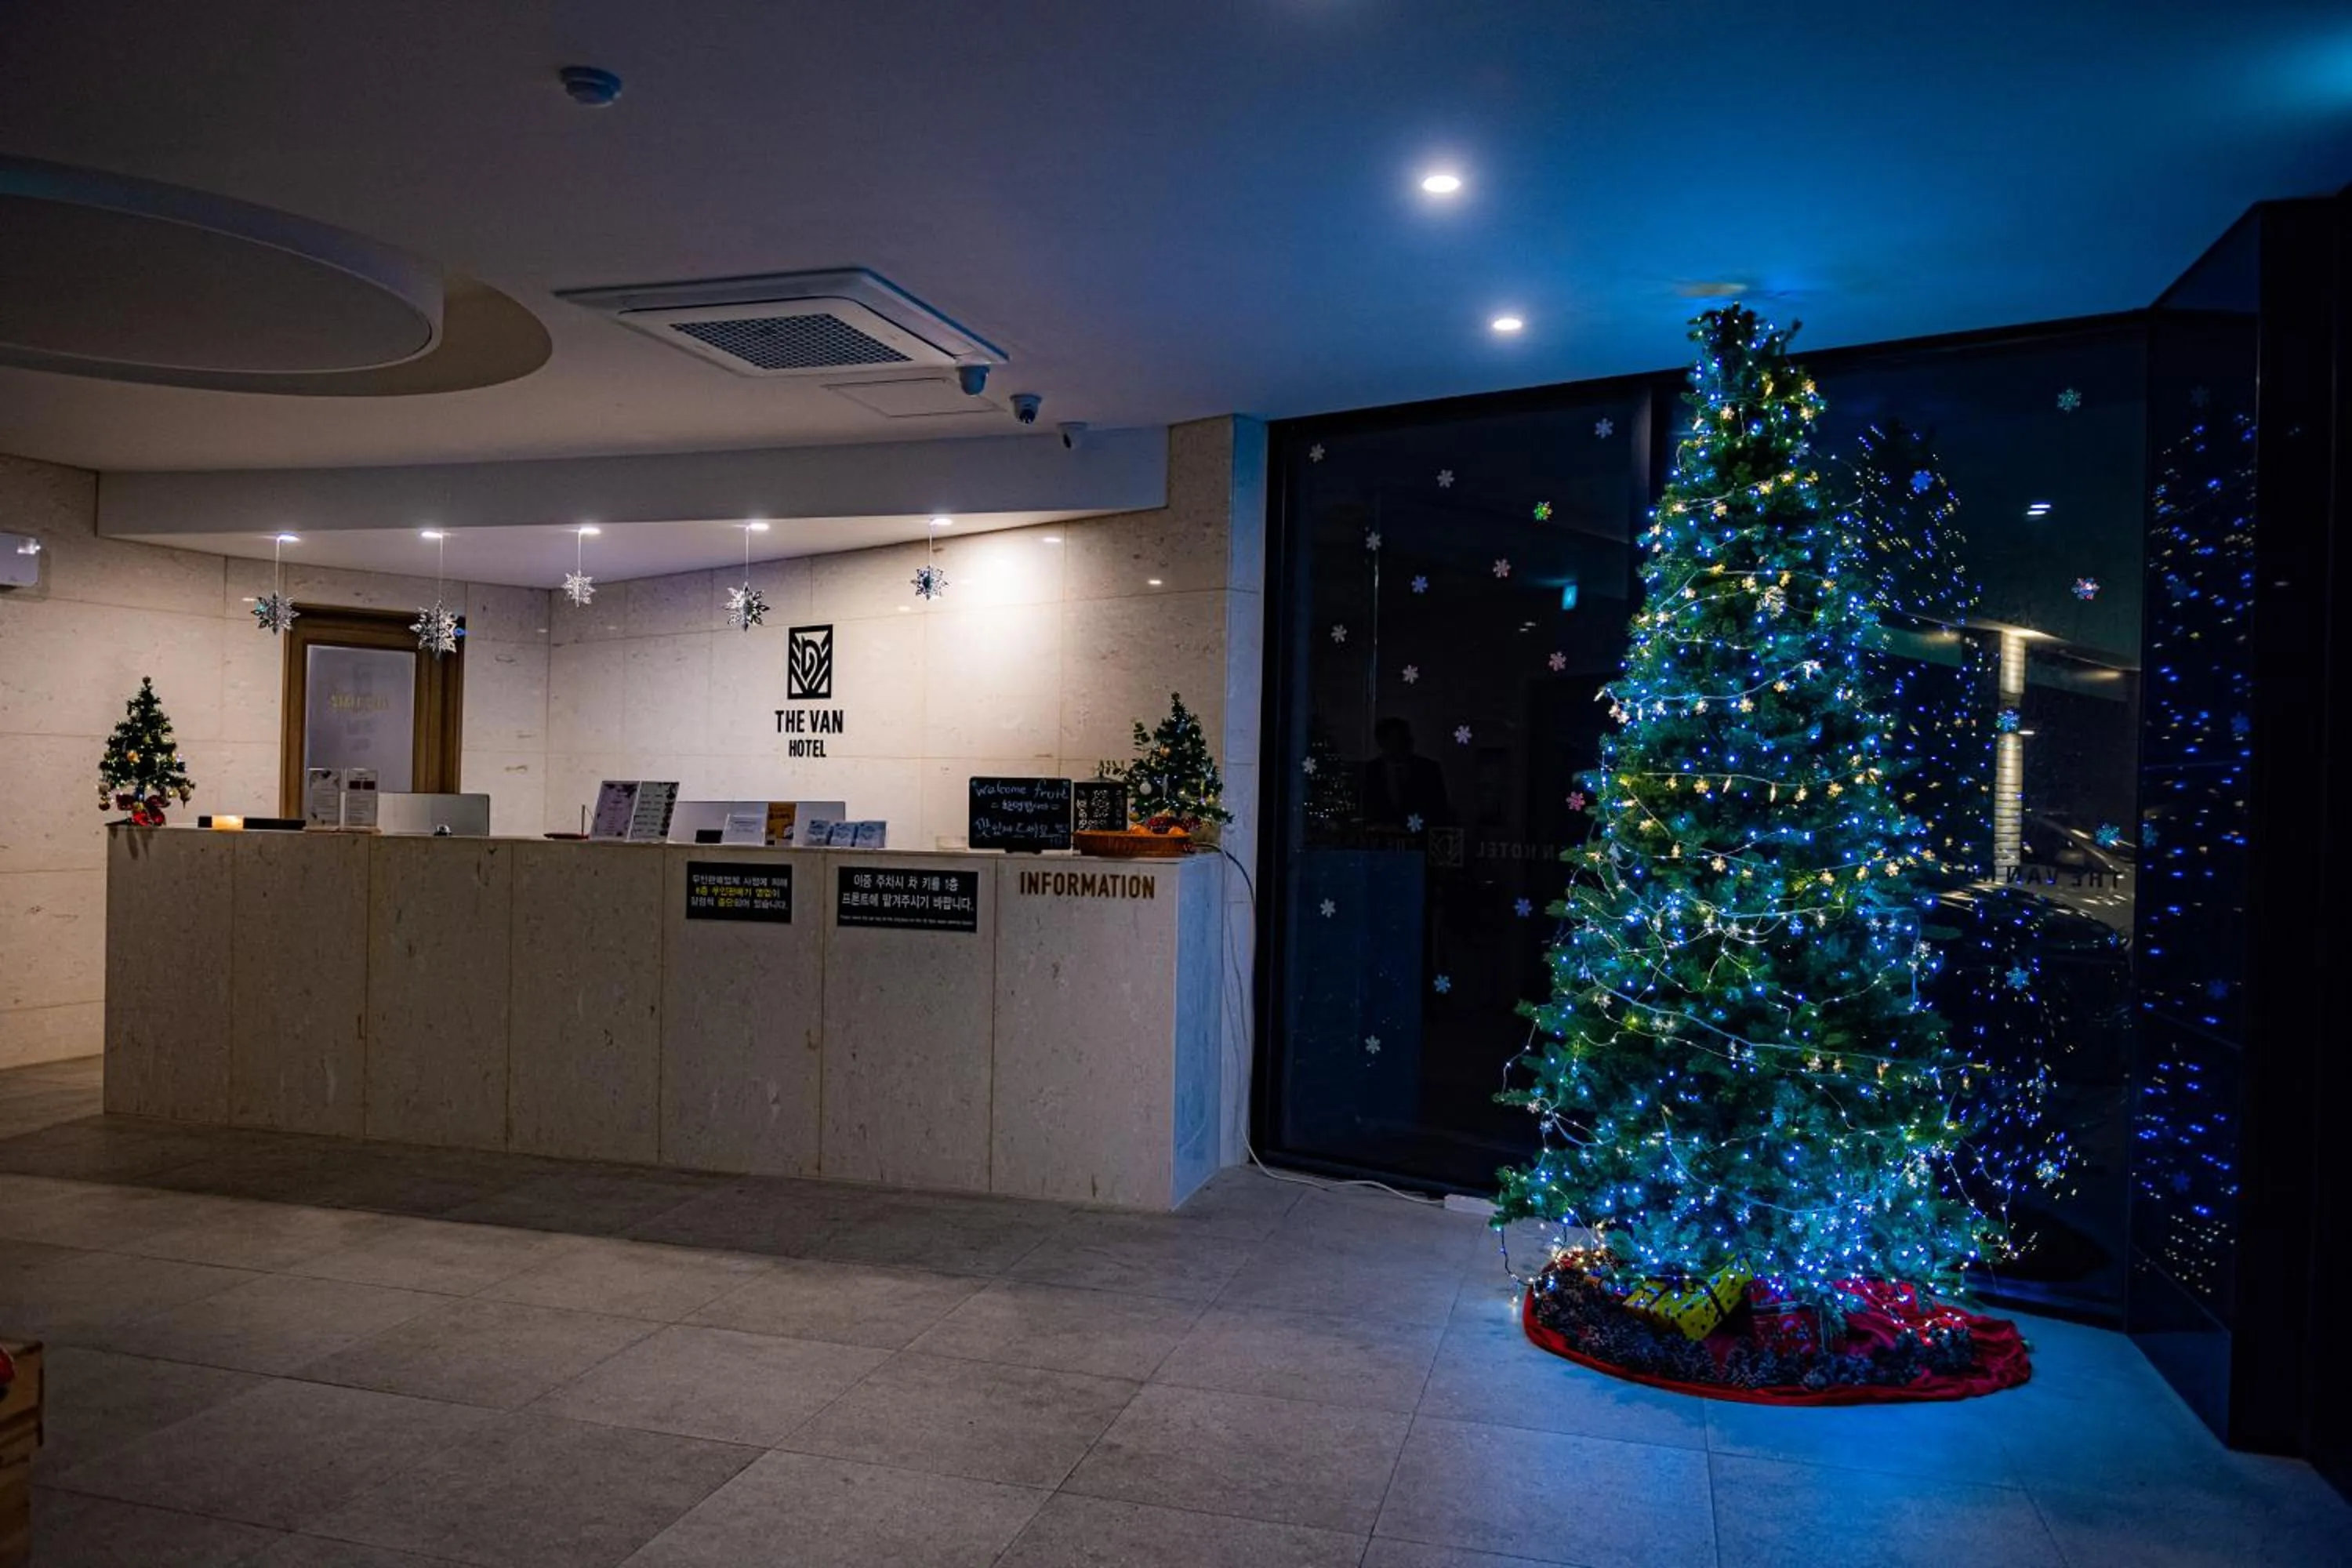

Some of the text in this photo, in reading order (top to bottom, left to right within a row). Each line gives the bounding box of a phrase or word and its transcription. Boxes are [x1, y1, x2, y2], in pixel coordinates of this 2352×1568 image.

[775, 710, 844, 734] THE VAN
[789, 739, 826, 758] HOTEL
[1033, 779, 1070, 800] fruit
[853, 873, 960, 892] 이중 주차시 차 키를 1층
[1020, 872, 1155, 899] INFORMATION
[841, 891, 975, 913] 프론트에 맡겨주시기 바랍니다.
